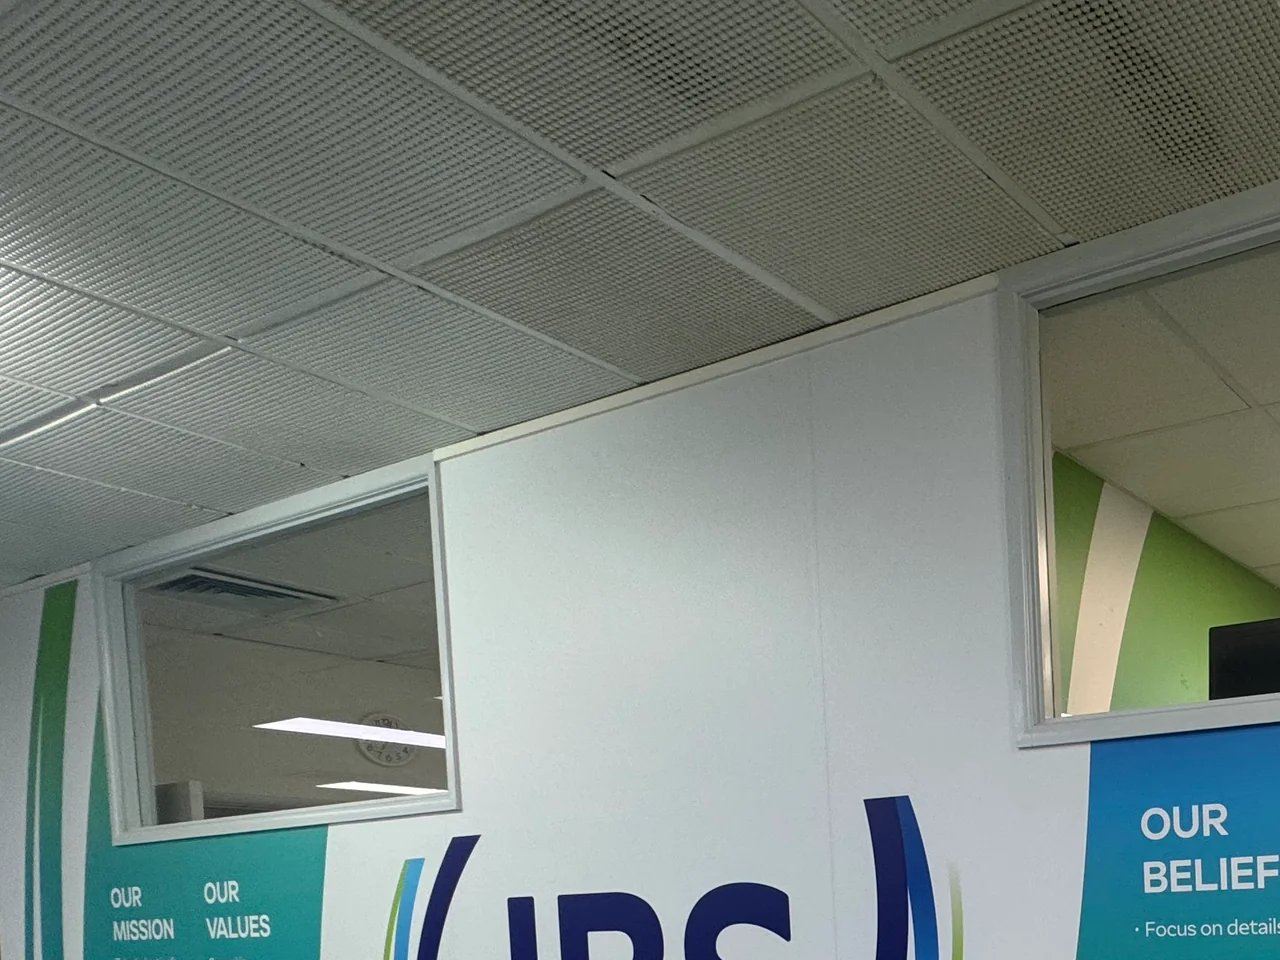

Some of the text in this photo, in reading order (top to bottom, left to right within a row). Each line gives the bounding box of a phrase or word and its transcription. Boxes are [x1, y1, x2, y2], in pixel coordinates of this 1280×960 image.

[1140, 803, 1229, 840] OUR
[110, 886, 142, 908] OUR
[203, 880, 240, 904] OUR
[113, 918, 174, 941] MISSION
[205, 914, 271, 939] VALUES
[1145, 921, 1197, 937] Focus
[1200, 923, 1223, 936] on
